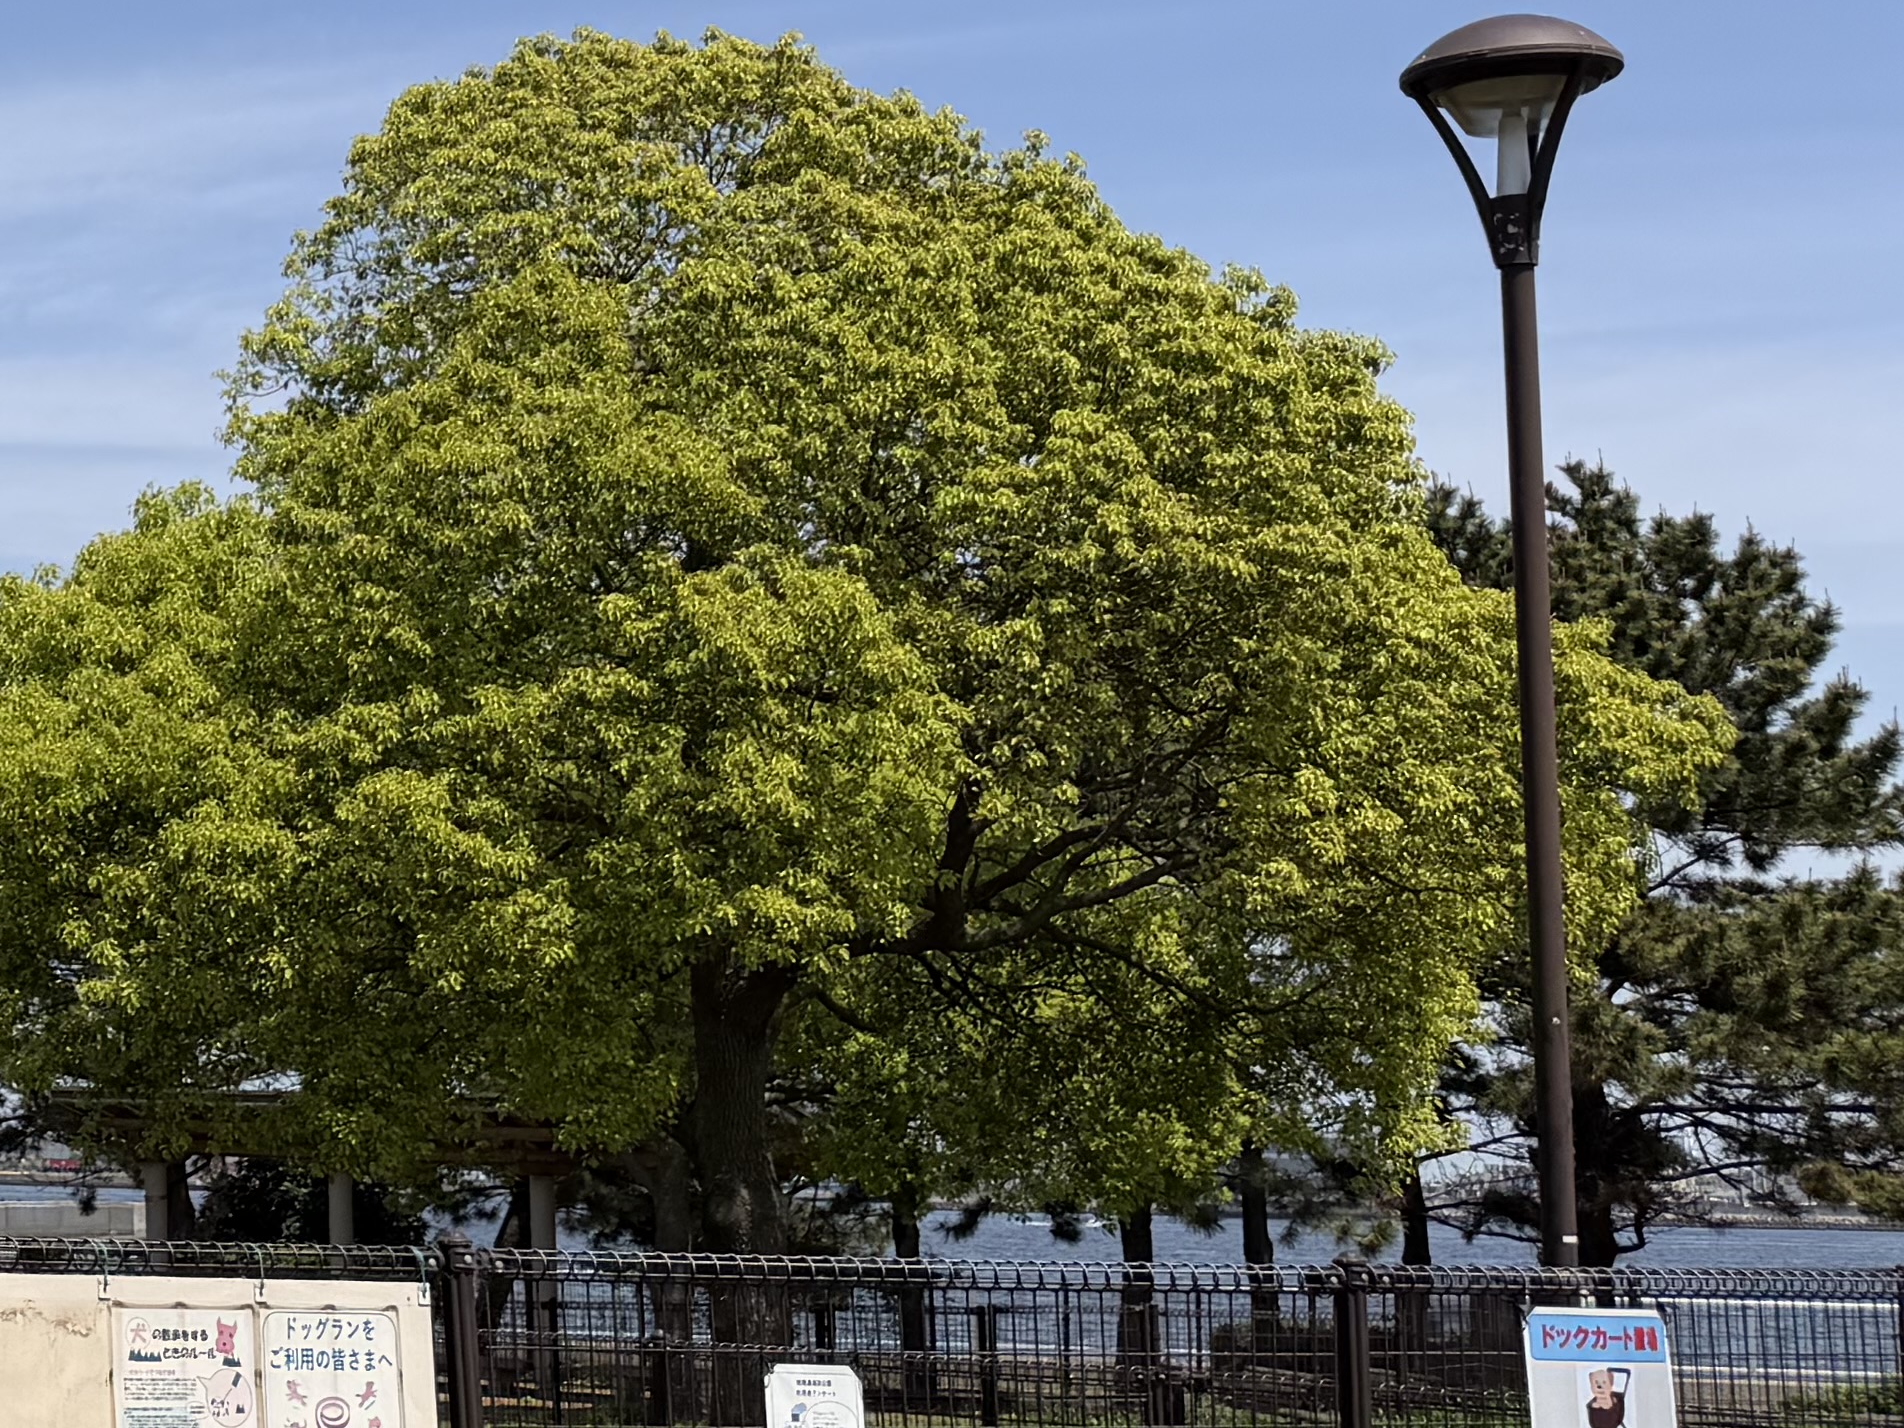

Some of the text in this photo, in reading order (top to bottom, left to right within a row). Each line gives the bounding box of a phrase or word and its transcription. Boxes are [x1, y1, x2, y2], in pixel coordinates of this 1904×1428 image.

[287, 1317, 375, 1341] ドッグランを
[270, 1347, 393, 1371] ご利用の皆さまへ
